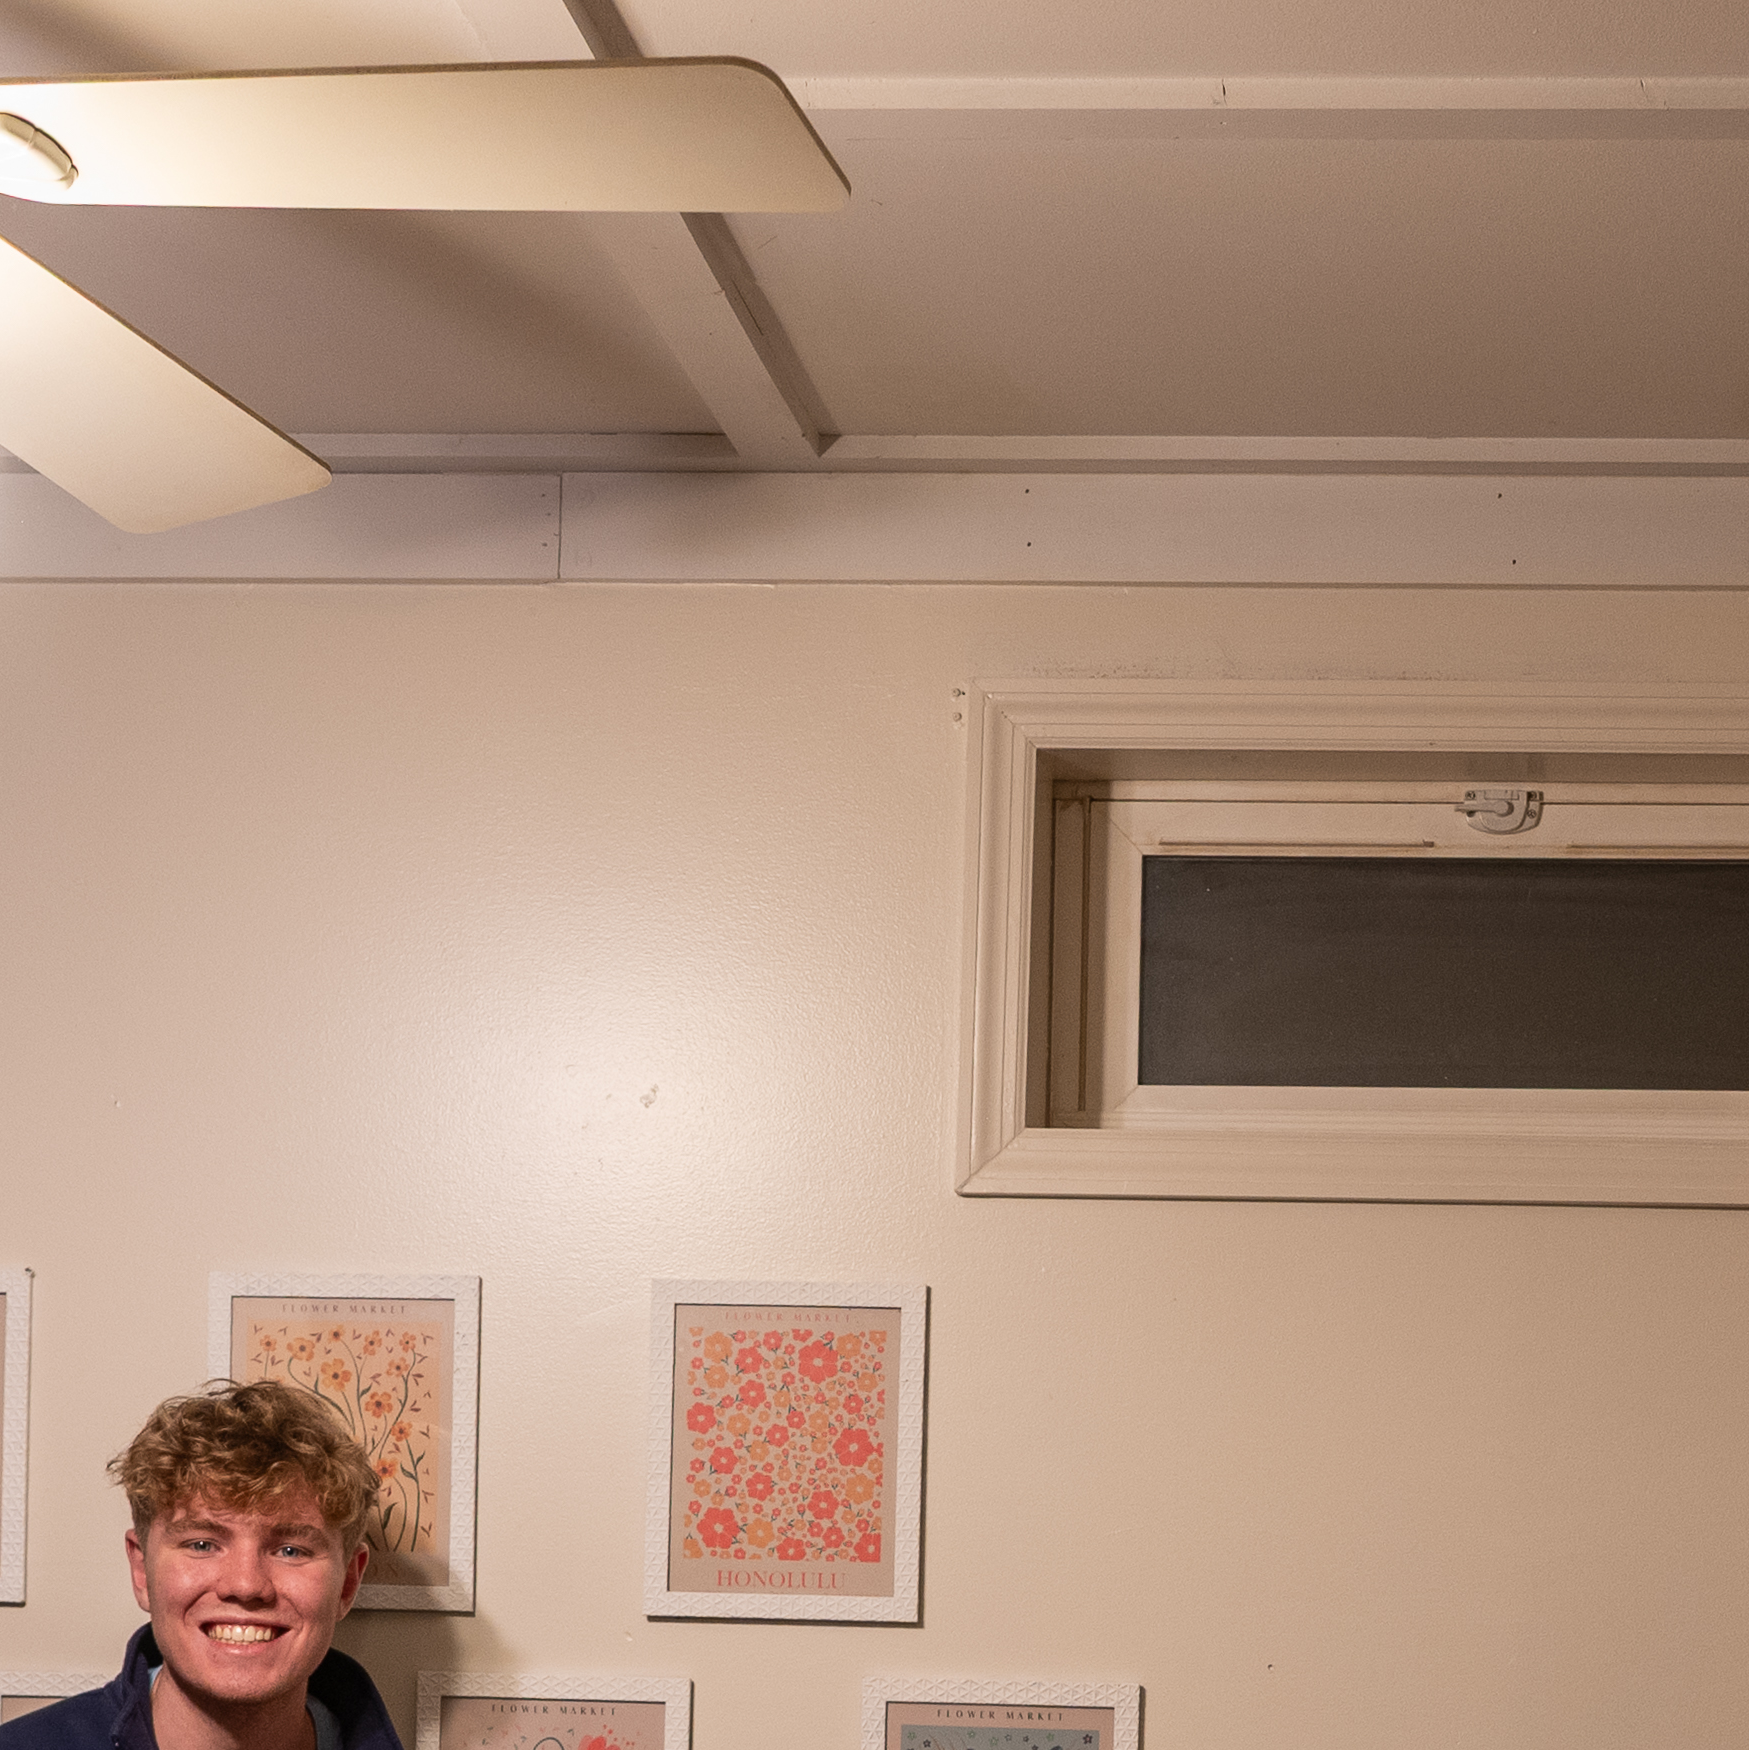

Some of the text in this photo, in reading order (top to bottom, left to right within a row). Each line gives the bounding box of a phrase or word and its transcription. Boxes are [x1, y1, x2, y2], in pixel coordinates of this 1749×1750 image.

[281, 1303, 406, 1315] FLOWER MARKET
[716, 1569, 846, 1589] HONOLULU
[491, 1703, 616, 1716] FLOWER MARKET
[936, 1708, 1063, 1722] FLOWER MARKET
